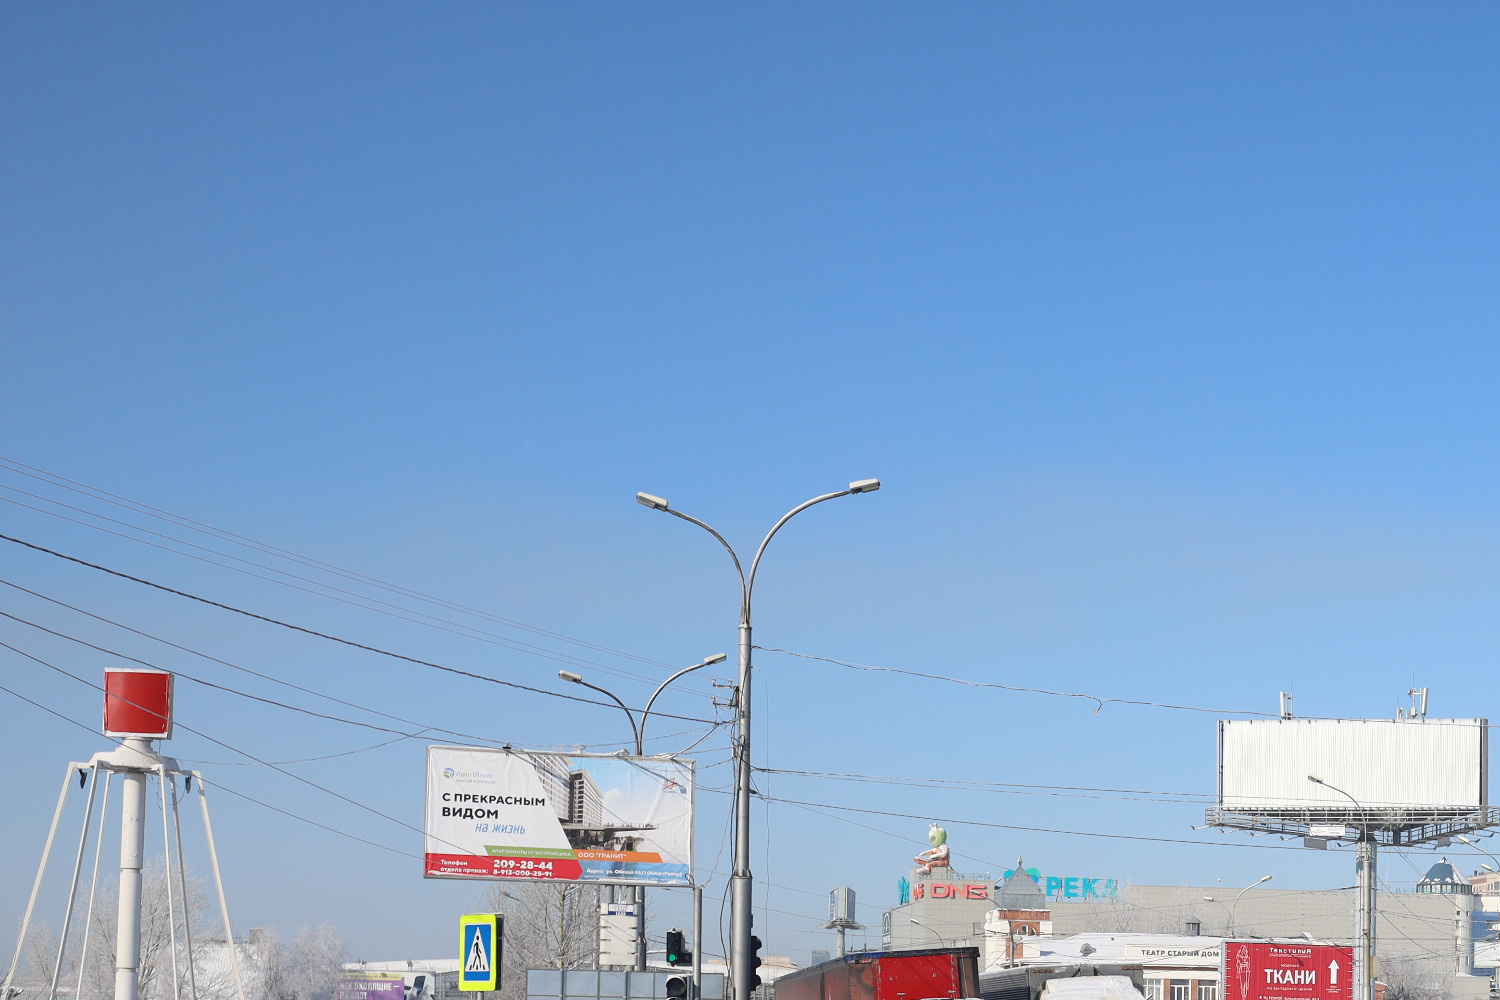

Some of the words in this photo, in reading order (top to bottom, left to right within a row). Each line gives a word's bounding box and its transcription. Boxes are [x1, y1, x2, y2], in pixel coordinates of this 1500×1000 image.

[442, 793, 451, 802] С
[454, 793, 546, 806] ПРЕКРАСНЫМ
[442, 807, 499, 820] ВИДОМ
[475, 823, 489, 833] на
[491, 824, 526, 835] жизнь
[441, 859, 468, 867] Телефон
[493, 859, 553, 870] 209-28-44
[440, 866, 462, 874] отдела
[493, 869, 553, 877] 8-913-000-25-91
[586, 867, 605, 875] Адрес:
[930, 883, 988, 900] DNS
[1046, 877, 1118, 899] РЕКА
[1167, 949, 1200, 957] СТАРЫЙ
[1264, 969, 1316, 985] ТКАНИ
